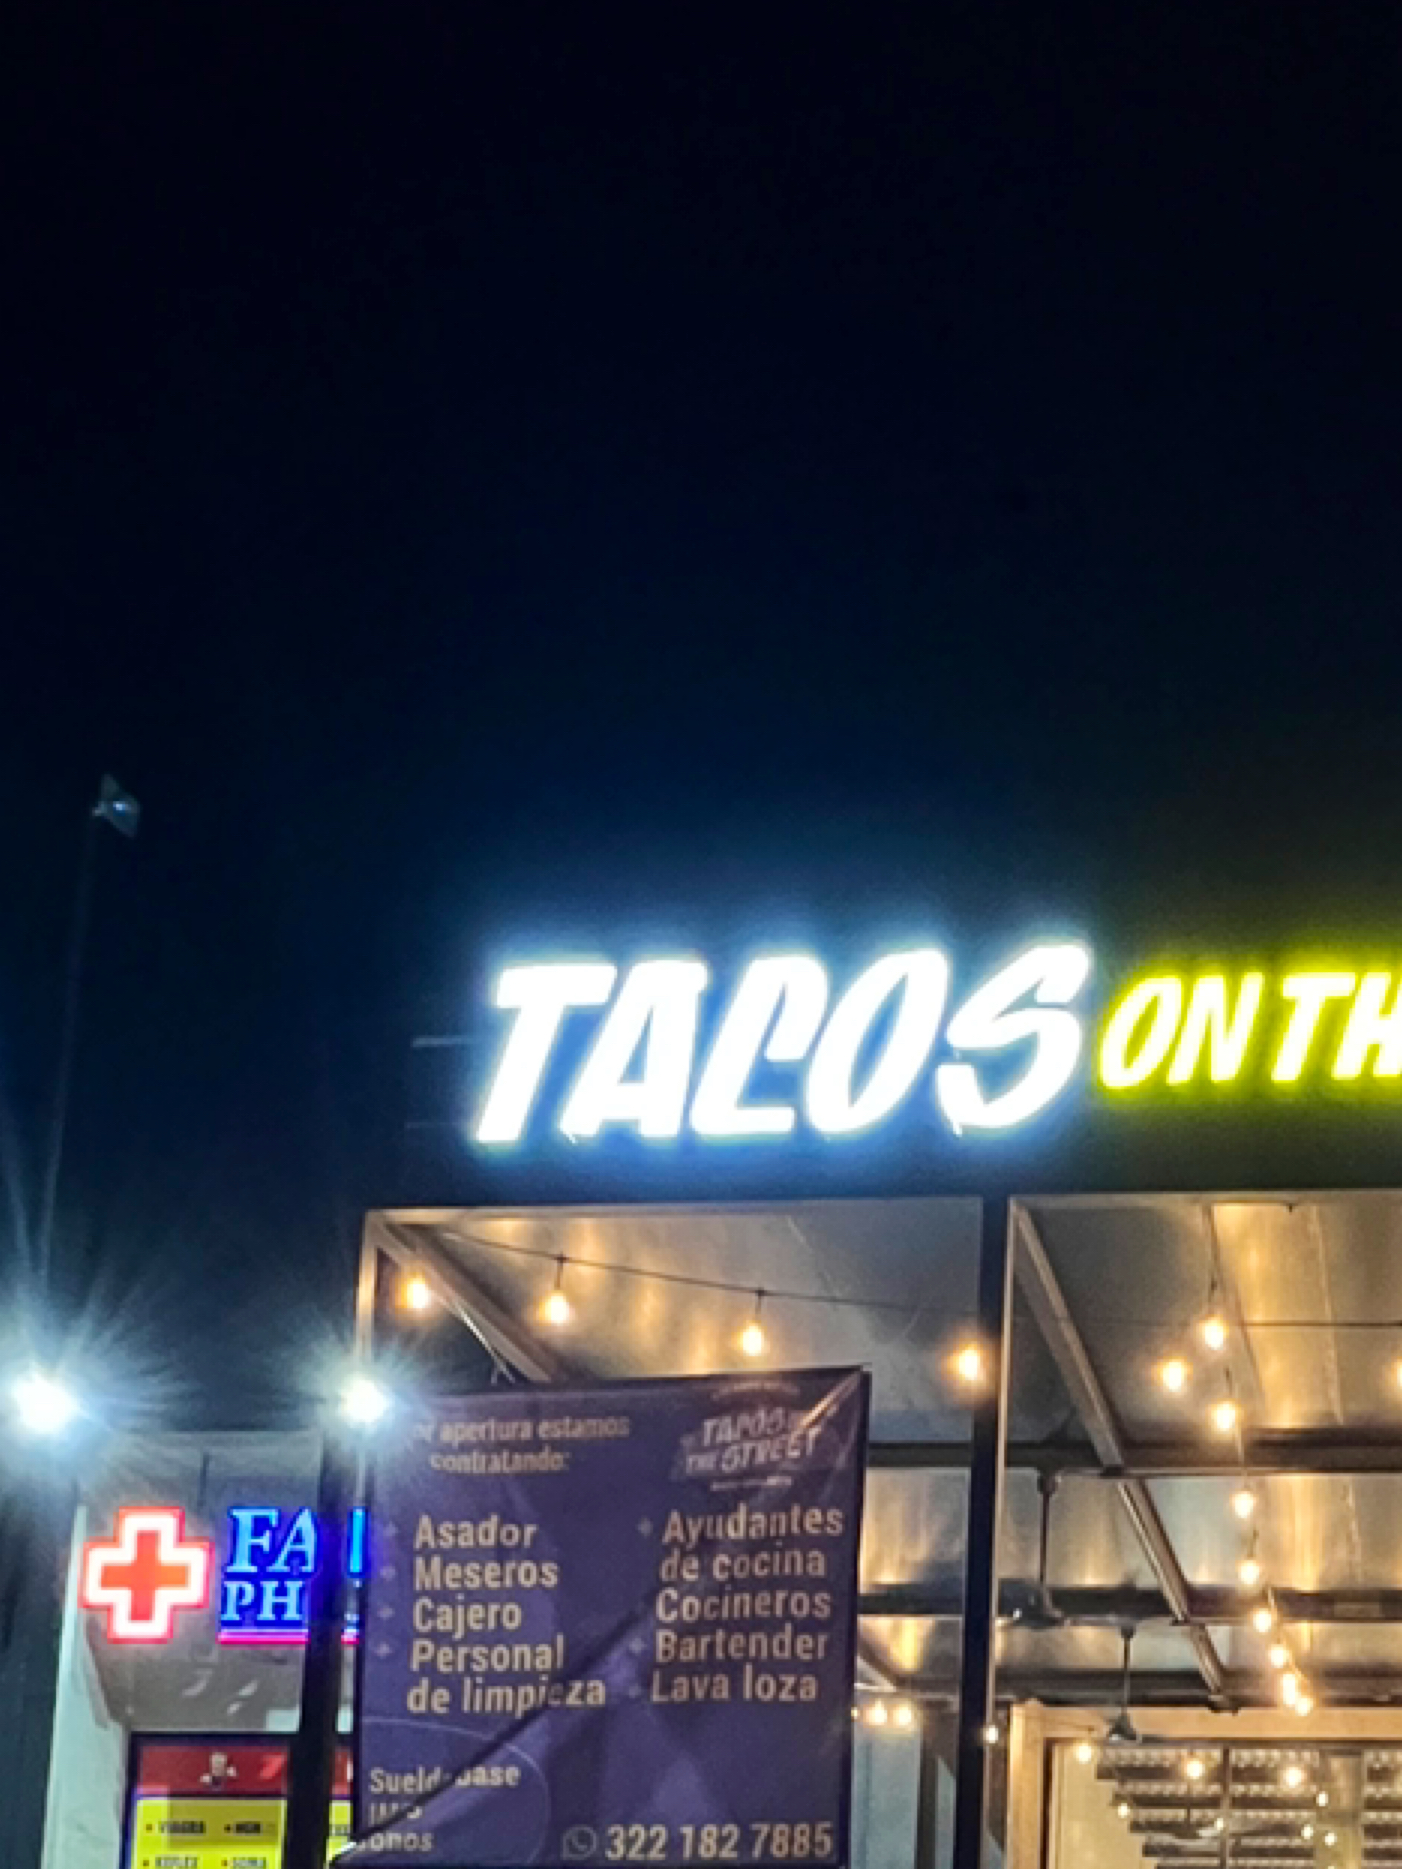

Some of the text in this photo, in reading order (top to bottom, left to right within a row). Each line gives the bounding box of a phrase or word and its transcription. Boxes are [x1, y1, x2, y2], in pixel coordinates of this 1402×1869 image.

[474, 943, 1093, 1144] TACOS
[1100, 971, 1266, 1088] ON
[440, 1415, 534, 1449] apertura
[537, 1414, 631, 1438] estamos
[414, 1512, 539, 1551] Asador
[660, 1502, 846, 1551] Ayudantes
[414, 1555, 559, 1591] Meseros
[659, 1539, 828, 1582] de cocina
[414, 1595, 522, 1639] Cajero
[655, 1583, 833, 1624] Cocineros
[409, 1631, 565, 1673] Personal
[655, 1622, 829, 1663] Bartender
[406, 1676, 451, 1715] de
[652, 1663, 820, 1702] Lava loza
[369, 1765, 452, 1795] Sueld
[605, 1820, 835, 1861] 322 182 7885
